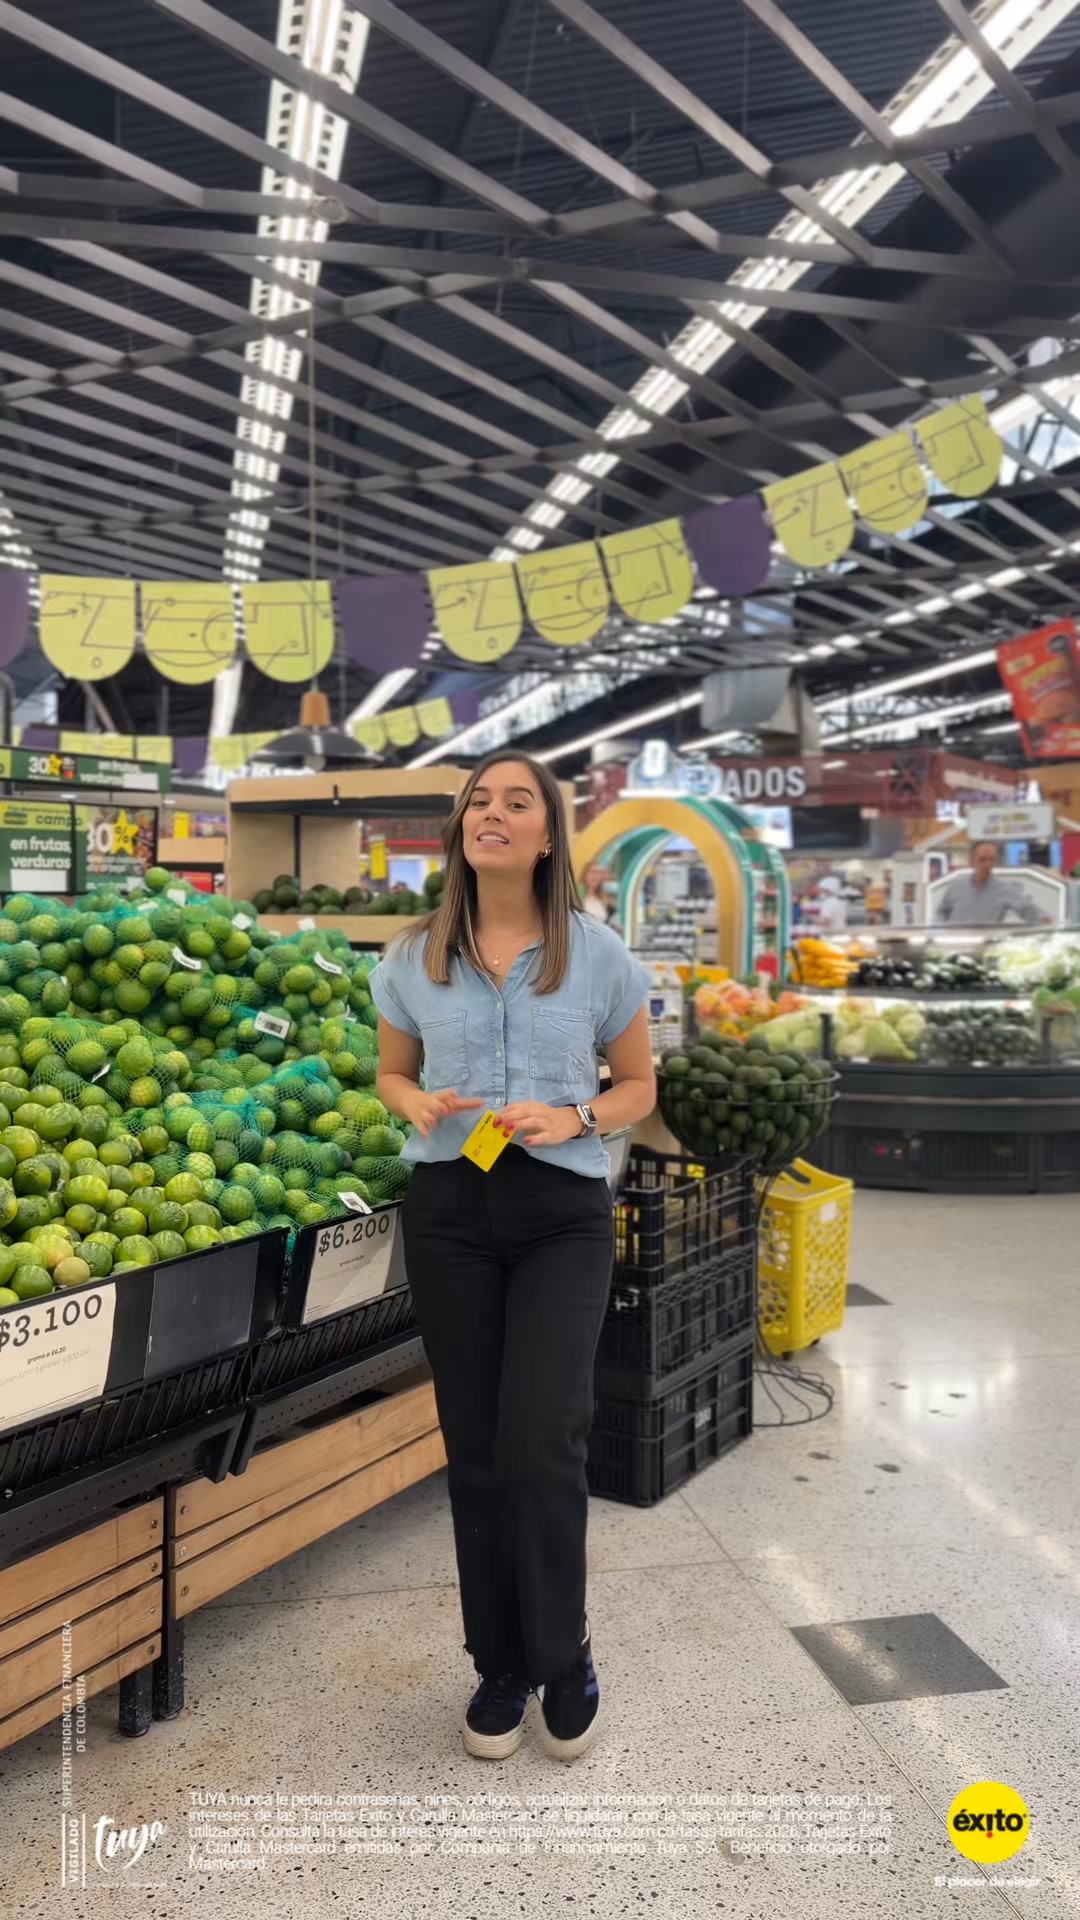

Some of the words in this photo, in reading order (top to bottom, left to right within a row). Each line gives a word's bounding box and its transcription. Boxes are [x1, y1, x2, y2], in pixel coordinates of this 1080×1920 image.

[10, 838, 27, 851] en
[30, 836, 72, 854] frutas,
[11, 854, 72, 869] verduras
[319, 1214, 390, 1257] $6.200
[0, 1294, 103, 1353] $3.100
